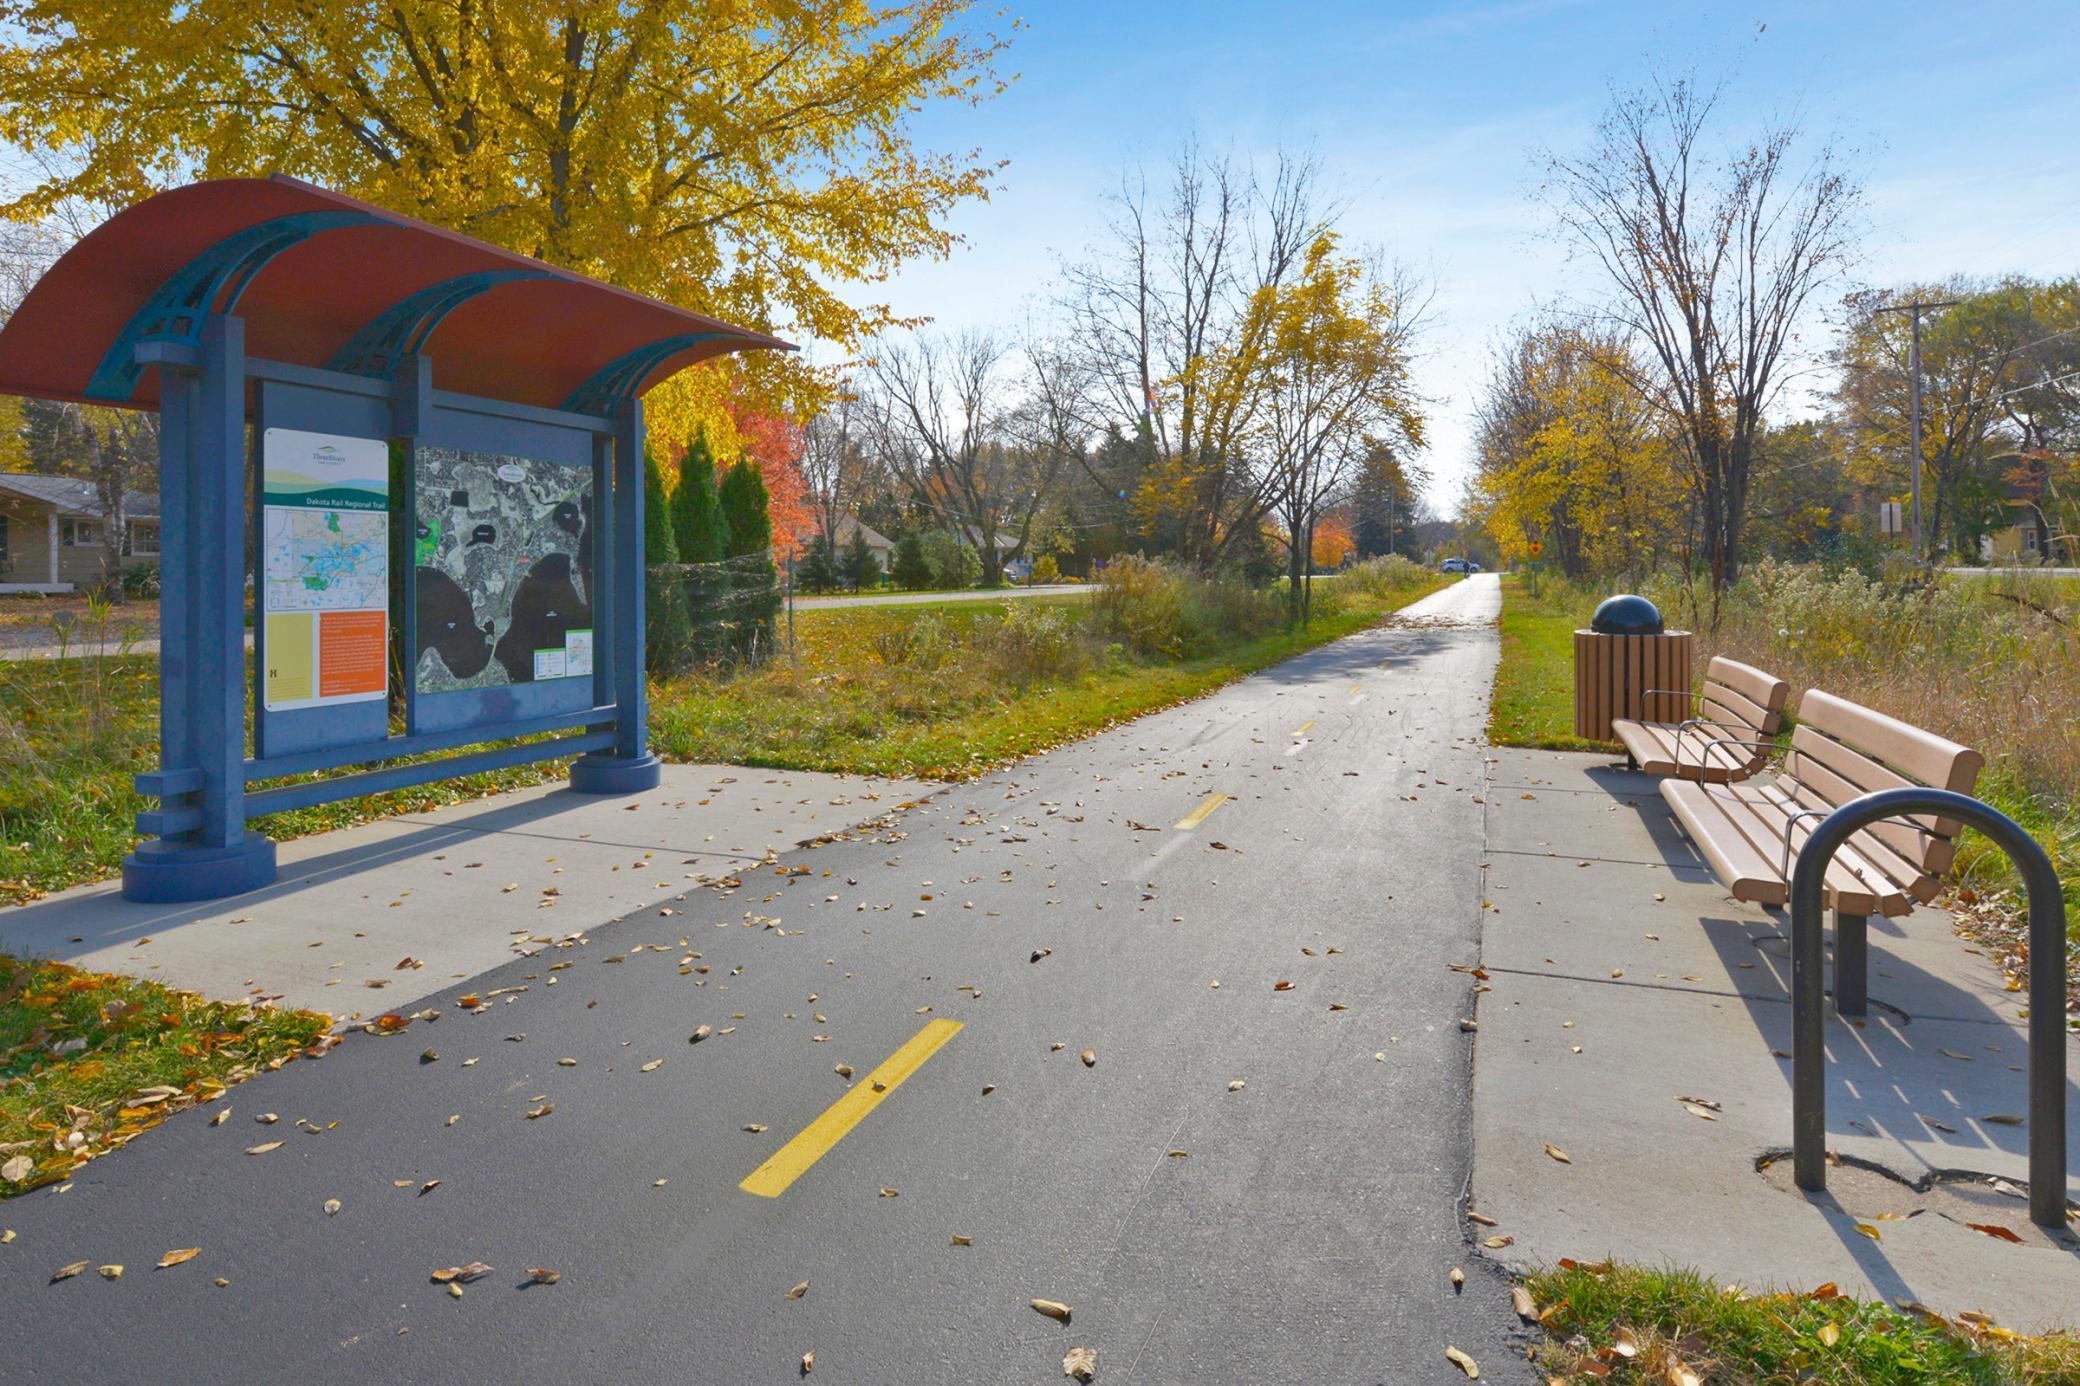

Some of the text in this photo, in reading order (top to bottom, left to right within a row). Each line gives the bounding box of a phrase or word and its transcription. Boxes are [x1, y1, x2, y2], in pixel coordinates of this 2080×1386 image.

[306, 498, 386, 509] Dakota Rail Regional Trail
